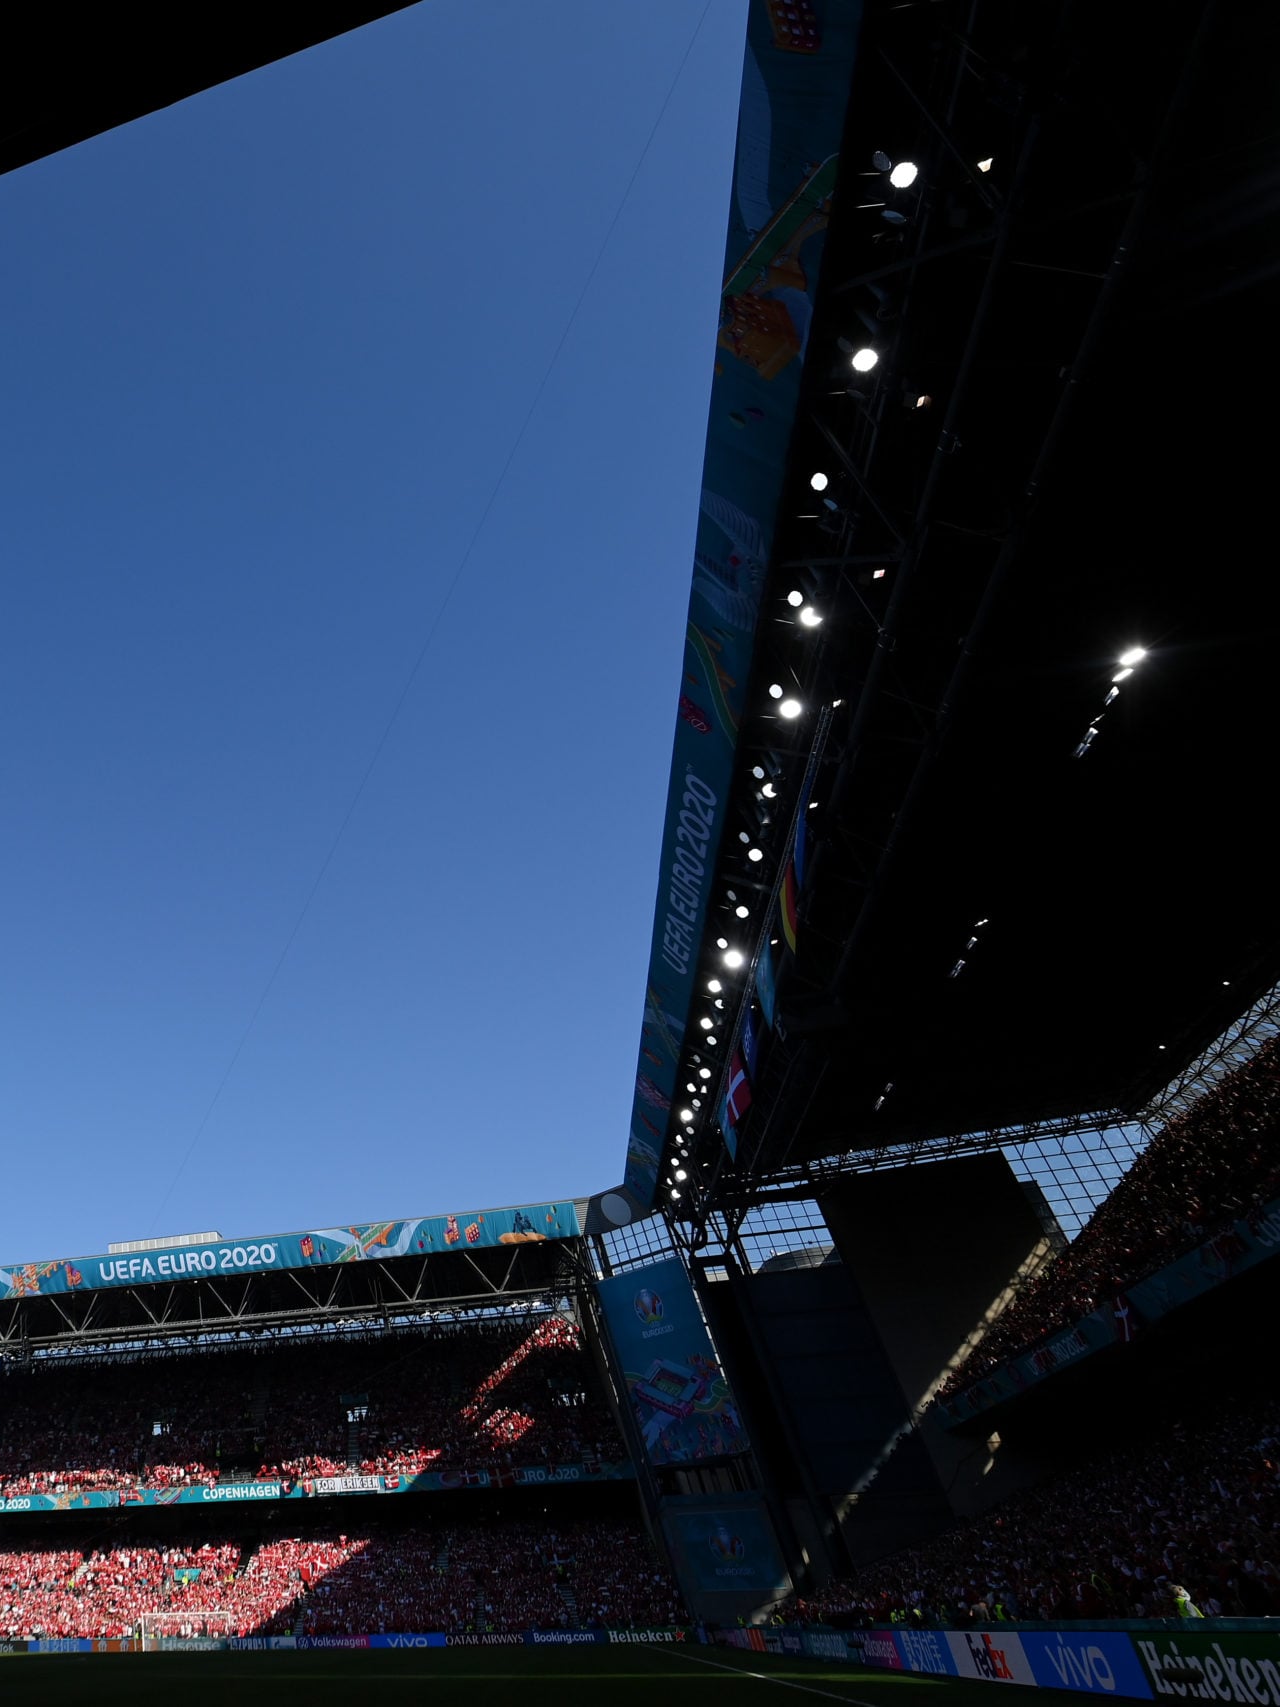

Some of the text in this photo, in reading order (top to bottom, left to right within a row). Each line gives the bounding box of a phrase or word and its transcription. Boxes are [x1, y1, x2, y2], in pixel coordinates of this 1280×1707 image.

[662, 773, 718, 975] UEFA EURO 2020
[99, 1260, 156, 1281] UEFA
[157, 1251, 216, 1275] EURO
[219, 1243, 276, 1269] 2020
[316, 1477, 379, 1490] FOR ERIKSEN
[202, 1485, 280, 1500] COPENHAGEN
[5, 1498, 31, 1510] 2020
[310, 1636, 367, 1648] Volkswagen
[387, 1634, 428, 1648] vivo
[445, 1632, 524, 1646] QATAR AIRWAYS
[533, 1630, 595, 1645] Booking.com
[607, 1629, 675, 1643] Heineken
[162, 1639, 221, 1651] Hisense
[965, 1633, 1014, 1680] FedEx
[1044, 1632, 1116, 1691] vivo
